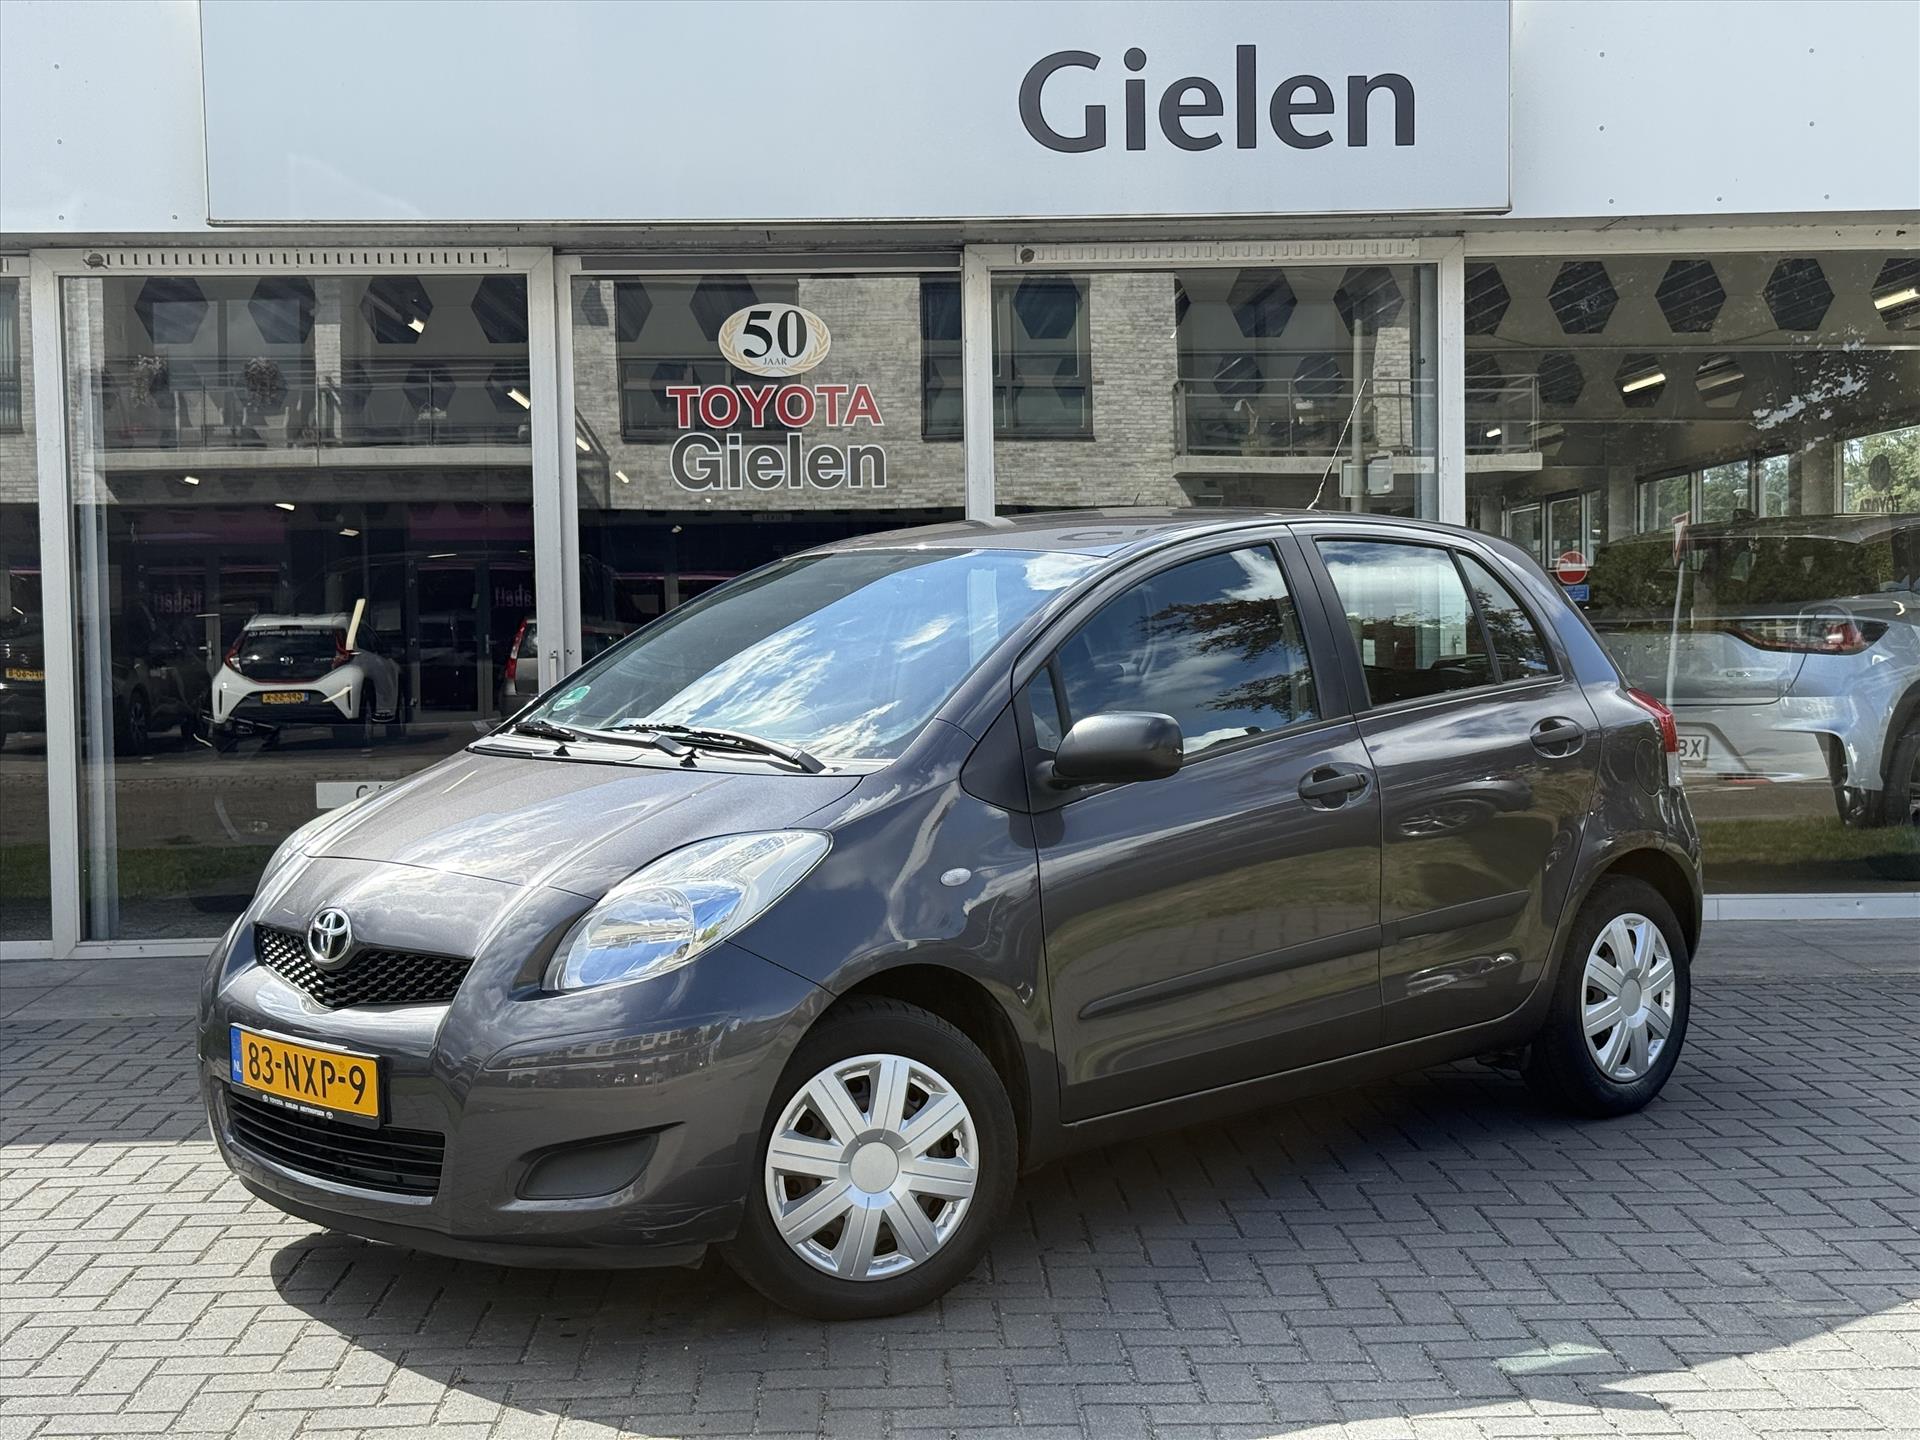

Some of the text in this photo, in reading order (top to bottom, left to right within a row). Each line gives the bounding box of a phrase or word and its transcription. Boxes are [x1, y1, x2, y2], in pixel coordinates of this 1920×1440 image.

[1018, 44, 1416, 153] Gielen
[743, 310, 808, 358] 50
[763, 358, 788, 366] JAAR
[666, 384, 884, 430] TOYOTA
[670, 432, 887, 492] Gielen
[233, 1059, 242, 1073] NL
[248, 1042, 367, 1105] 83-NXP-9
